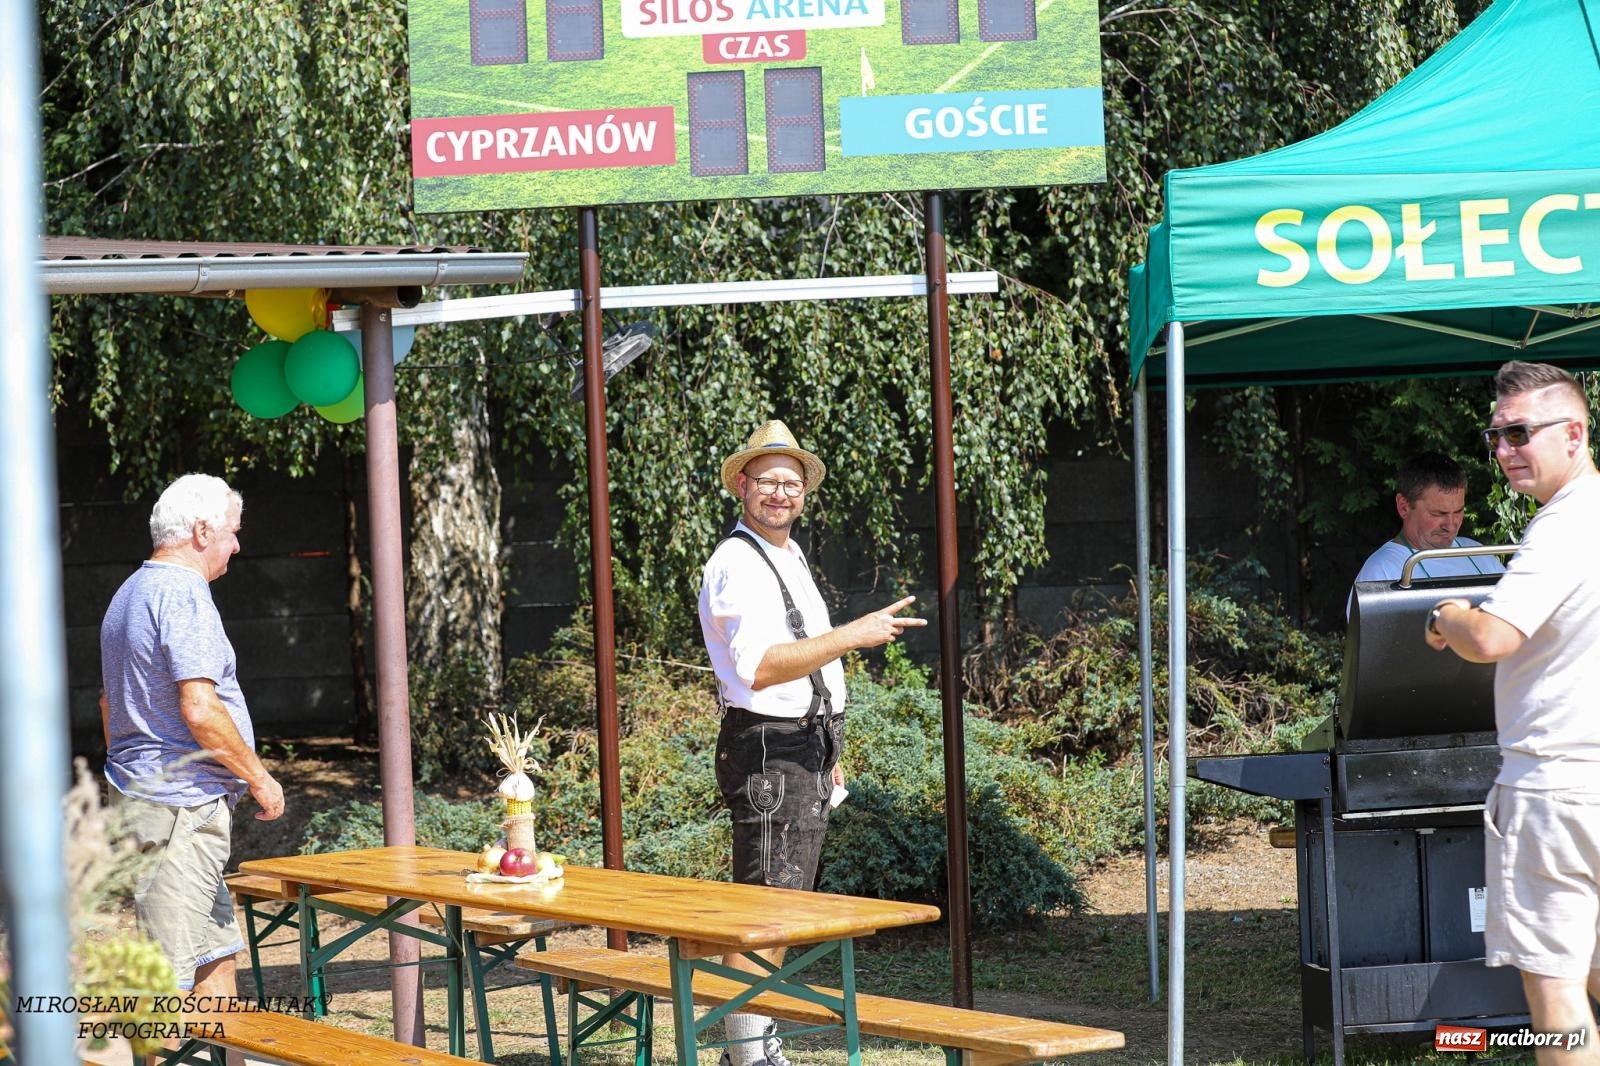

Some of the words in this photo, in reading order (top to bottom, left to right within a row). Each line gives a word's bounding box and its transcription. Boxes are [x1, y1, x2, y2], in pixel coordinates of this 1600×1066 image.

[639, 0, 734, 25] SILOS
[745, 0, 869, 20] ARENA
[718, 34, 791, 60] CZAS
[904, 96, 1048, 140] GOŚCIE
[426, 114, 657, 163] CYPRZANÓW
